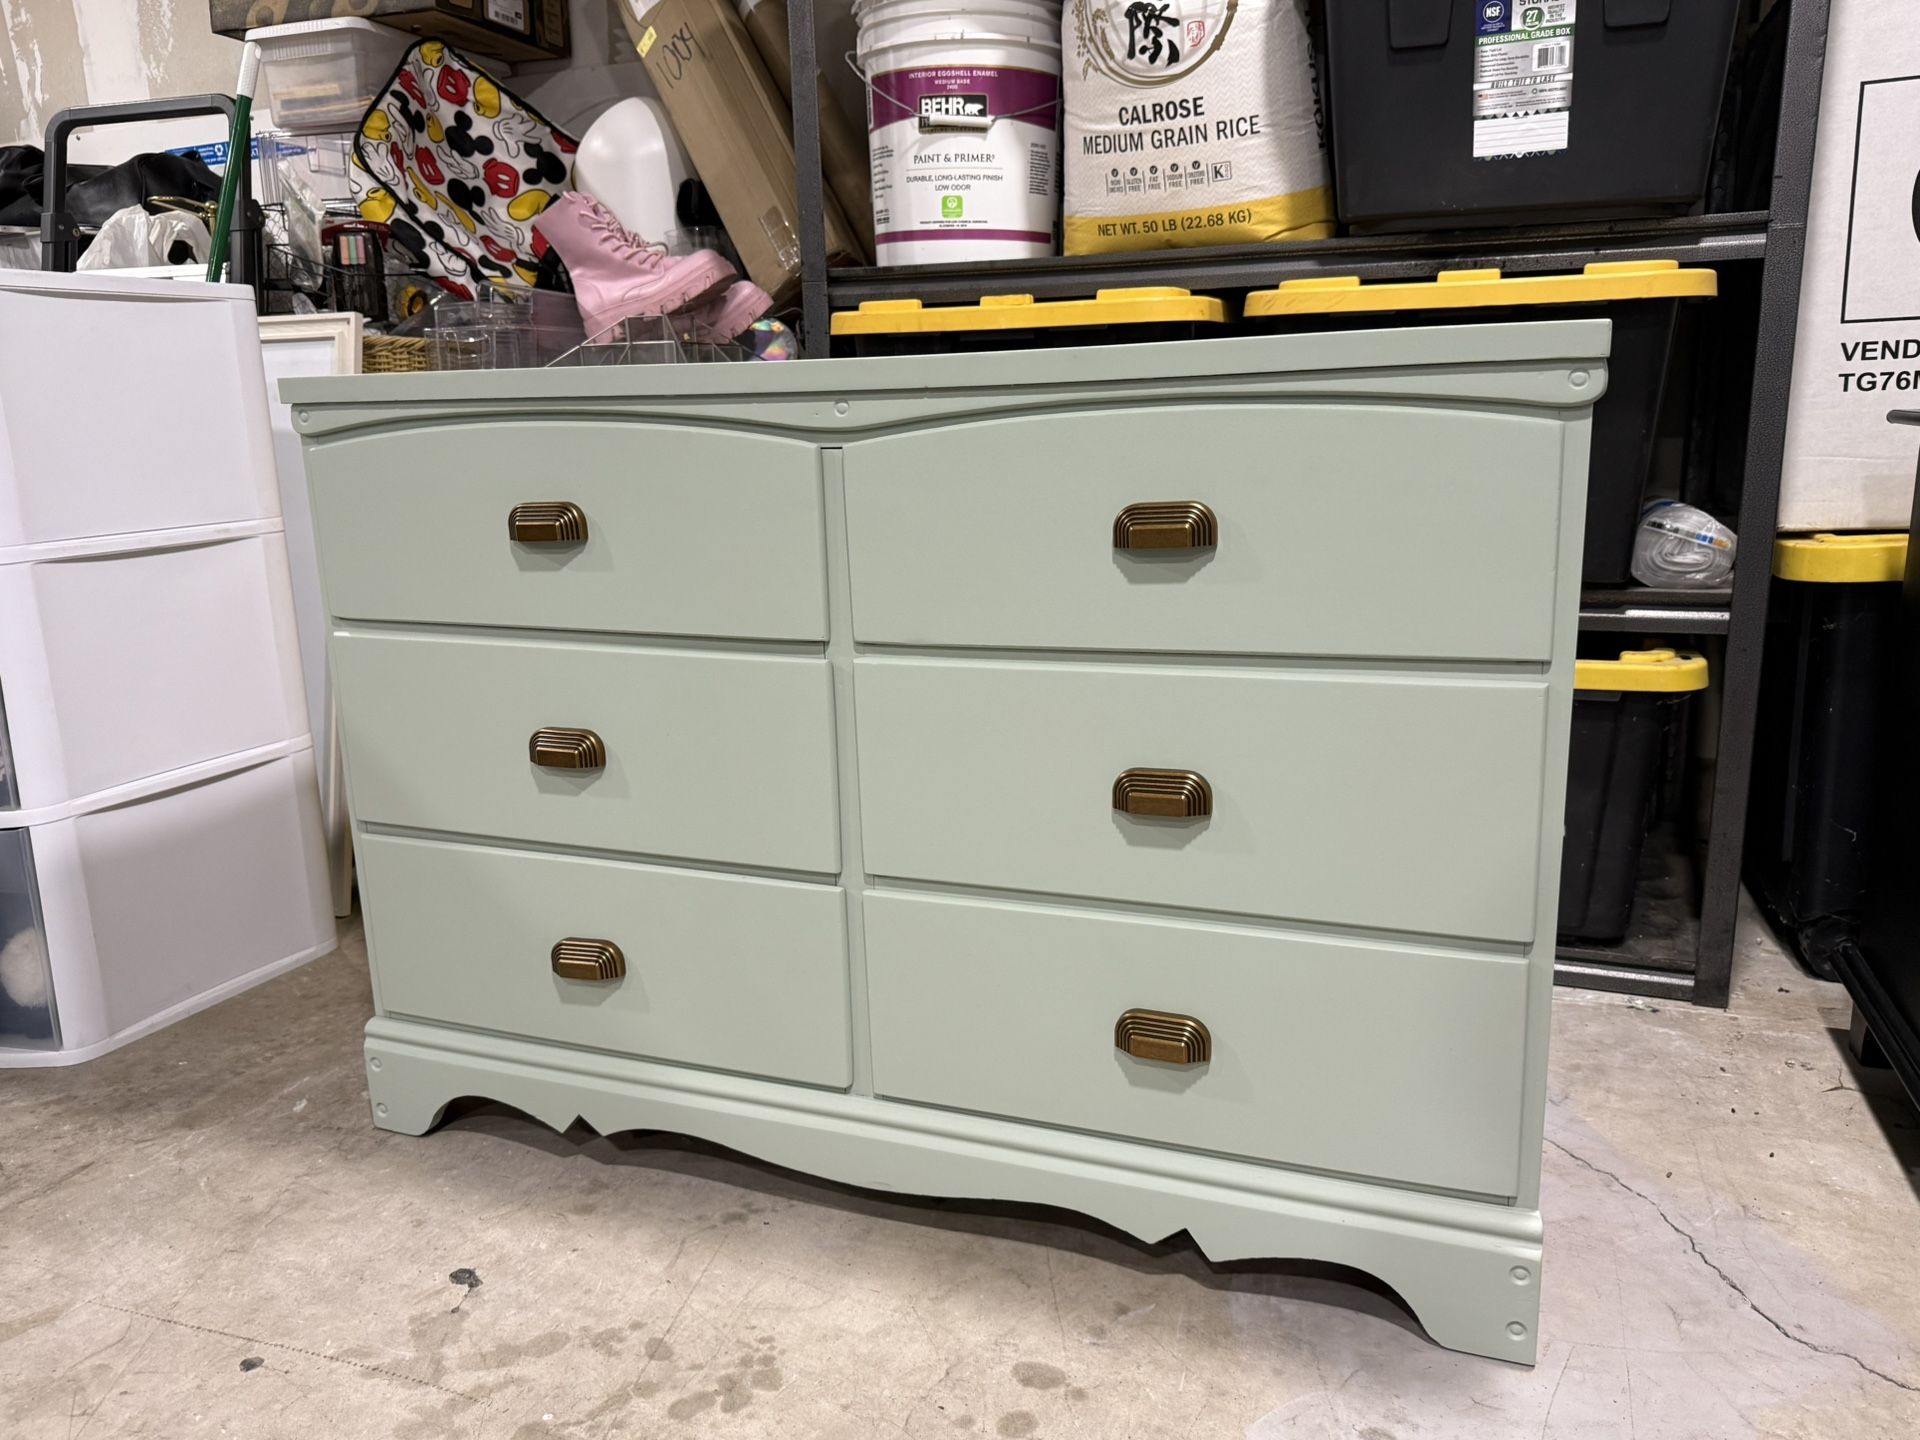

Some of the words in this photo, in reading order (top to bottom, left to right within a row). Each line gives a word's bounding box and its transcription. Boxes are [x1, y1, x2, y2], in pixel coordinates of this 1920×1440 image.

[1485, 6, 1501, 18] NSF
[1526, 9, 1539, 22] 27
[1478, 32, 1529, 45] PROFESSIONAL
[1530, 28, 1555, 39] GRADE
[1555, 27, 1571, 35] BOX
[909, 71, 936, 79] INTERIOR
[921, 97, 964, 115] BEHR
[1118, 96, 1205, 126] CALROSE
[1083, 132, 1144, 155] MEDIUM
[1151, 123, 1208, 149] GRAIN
[1216, 114, 1261, 140] RICE
[913, 154, 941, 164] PAINT
[943, 153, 951, 162] &
[906, 175, 933, 183] DURABLE,
[1097, 223, 1117, 237] NET
[1120, 222, 1141, 236] WT.
[1142, 220, 1158, 234] 50
[1162, 218, 1177, 232] LB
[1180, 212, 1224, 232] (22.68
[1228, 208, 1252, 225] KG)
[1840, 339, 1920, 361] VEND
